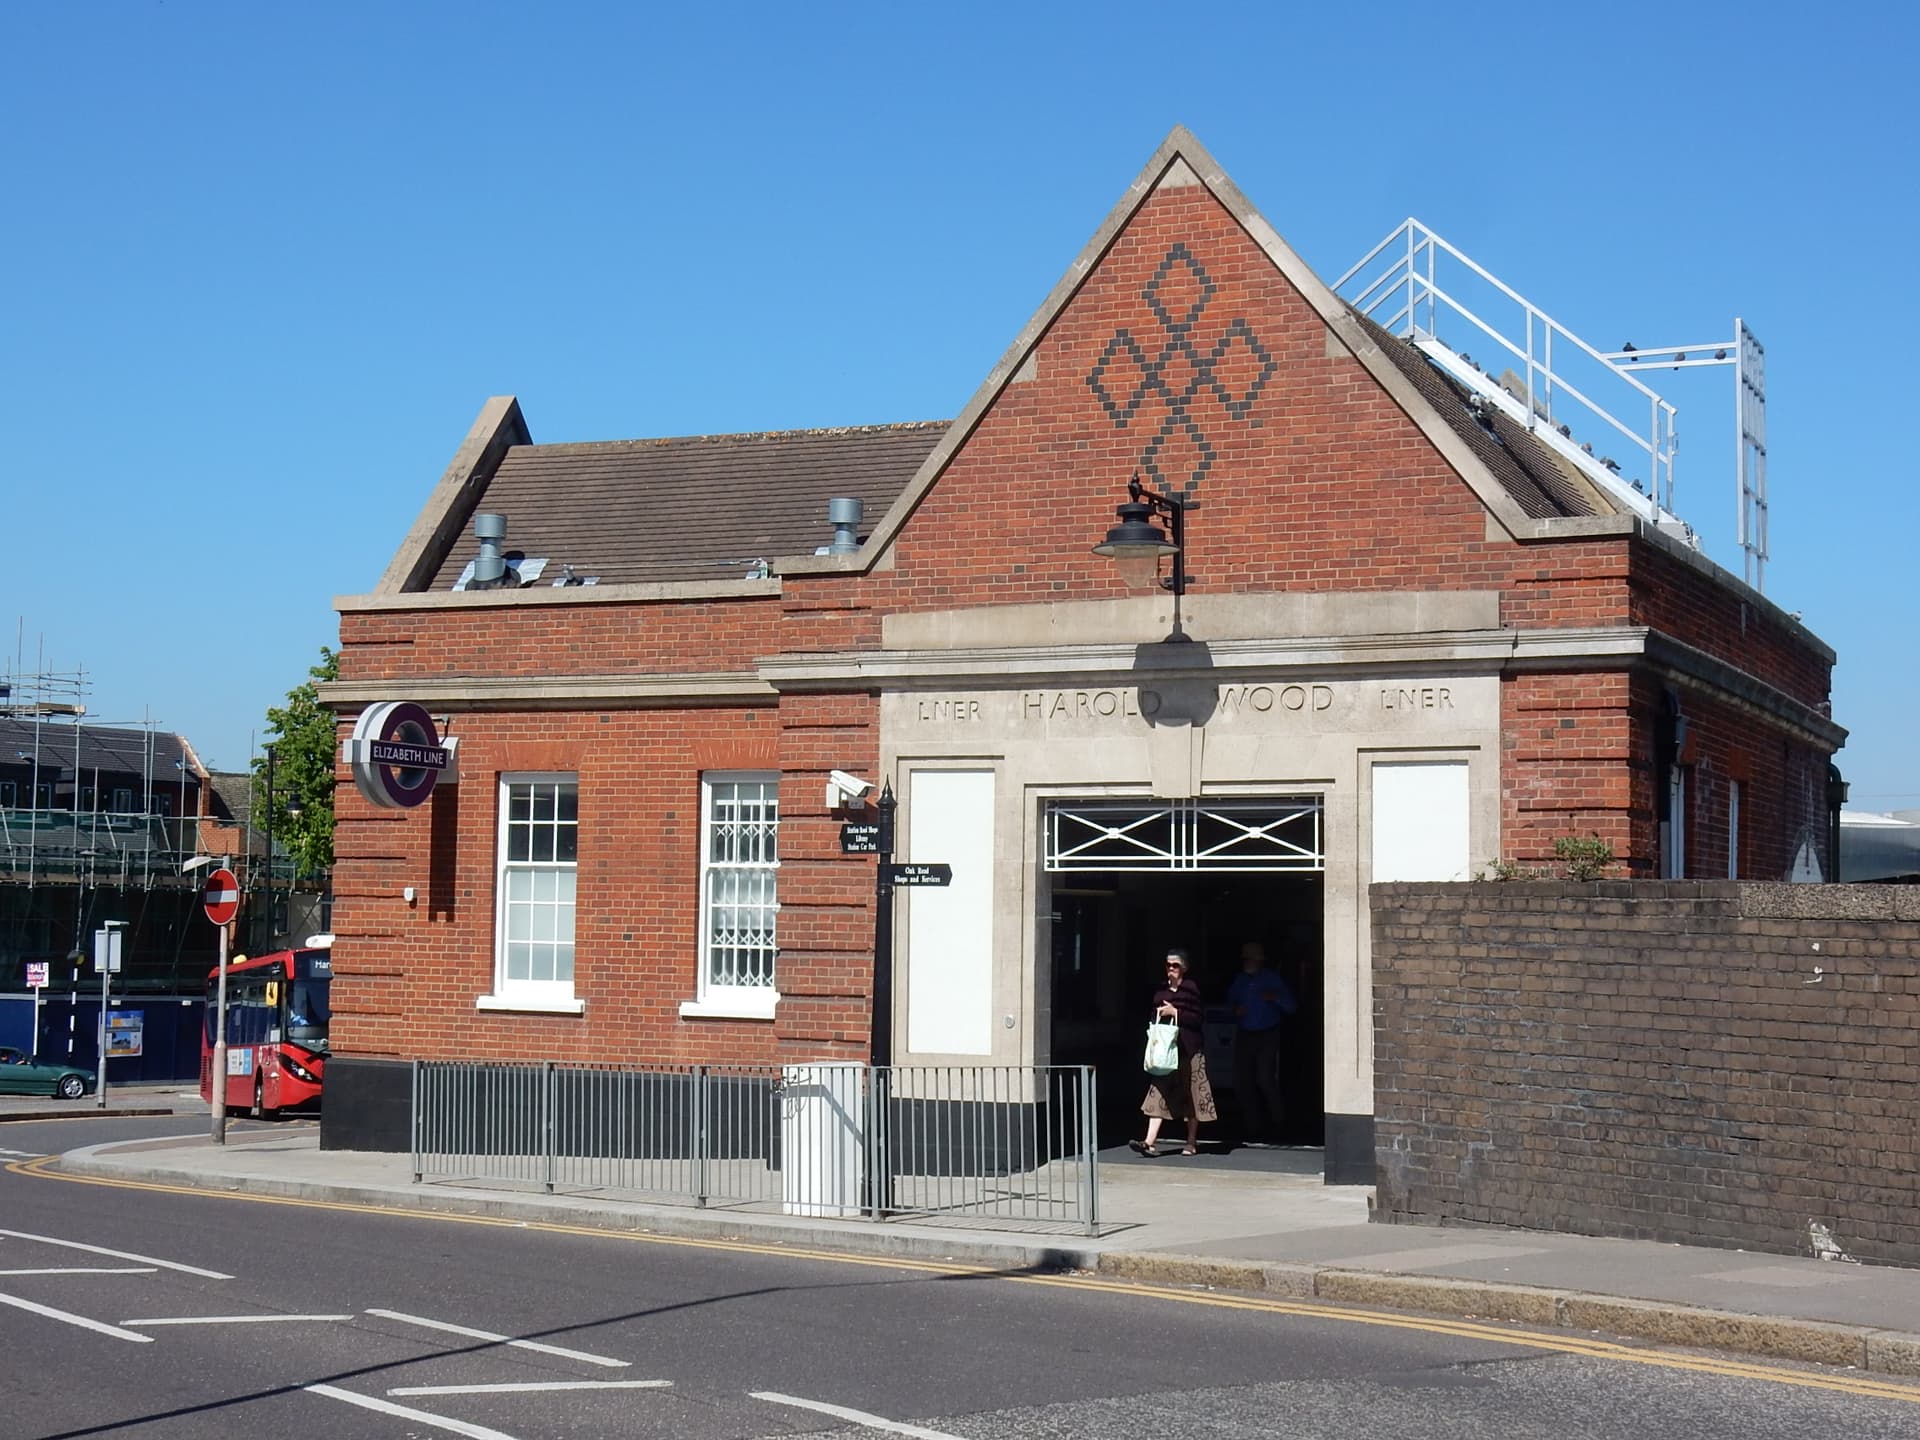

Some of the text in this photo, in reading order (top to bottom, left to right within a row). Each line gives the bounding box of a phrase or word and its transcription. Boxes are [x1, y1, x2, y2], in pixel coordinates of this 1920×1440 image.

[919, 700, 982, 721] LNER
[1023, 685, 1335, 720] HAROLD WOOD
[1381, 687, 1454, 712] LNER
[373, 746, 444, 765] ELIZABETH LINE
